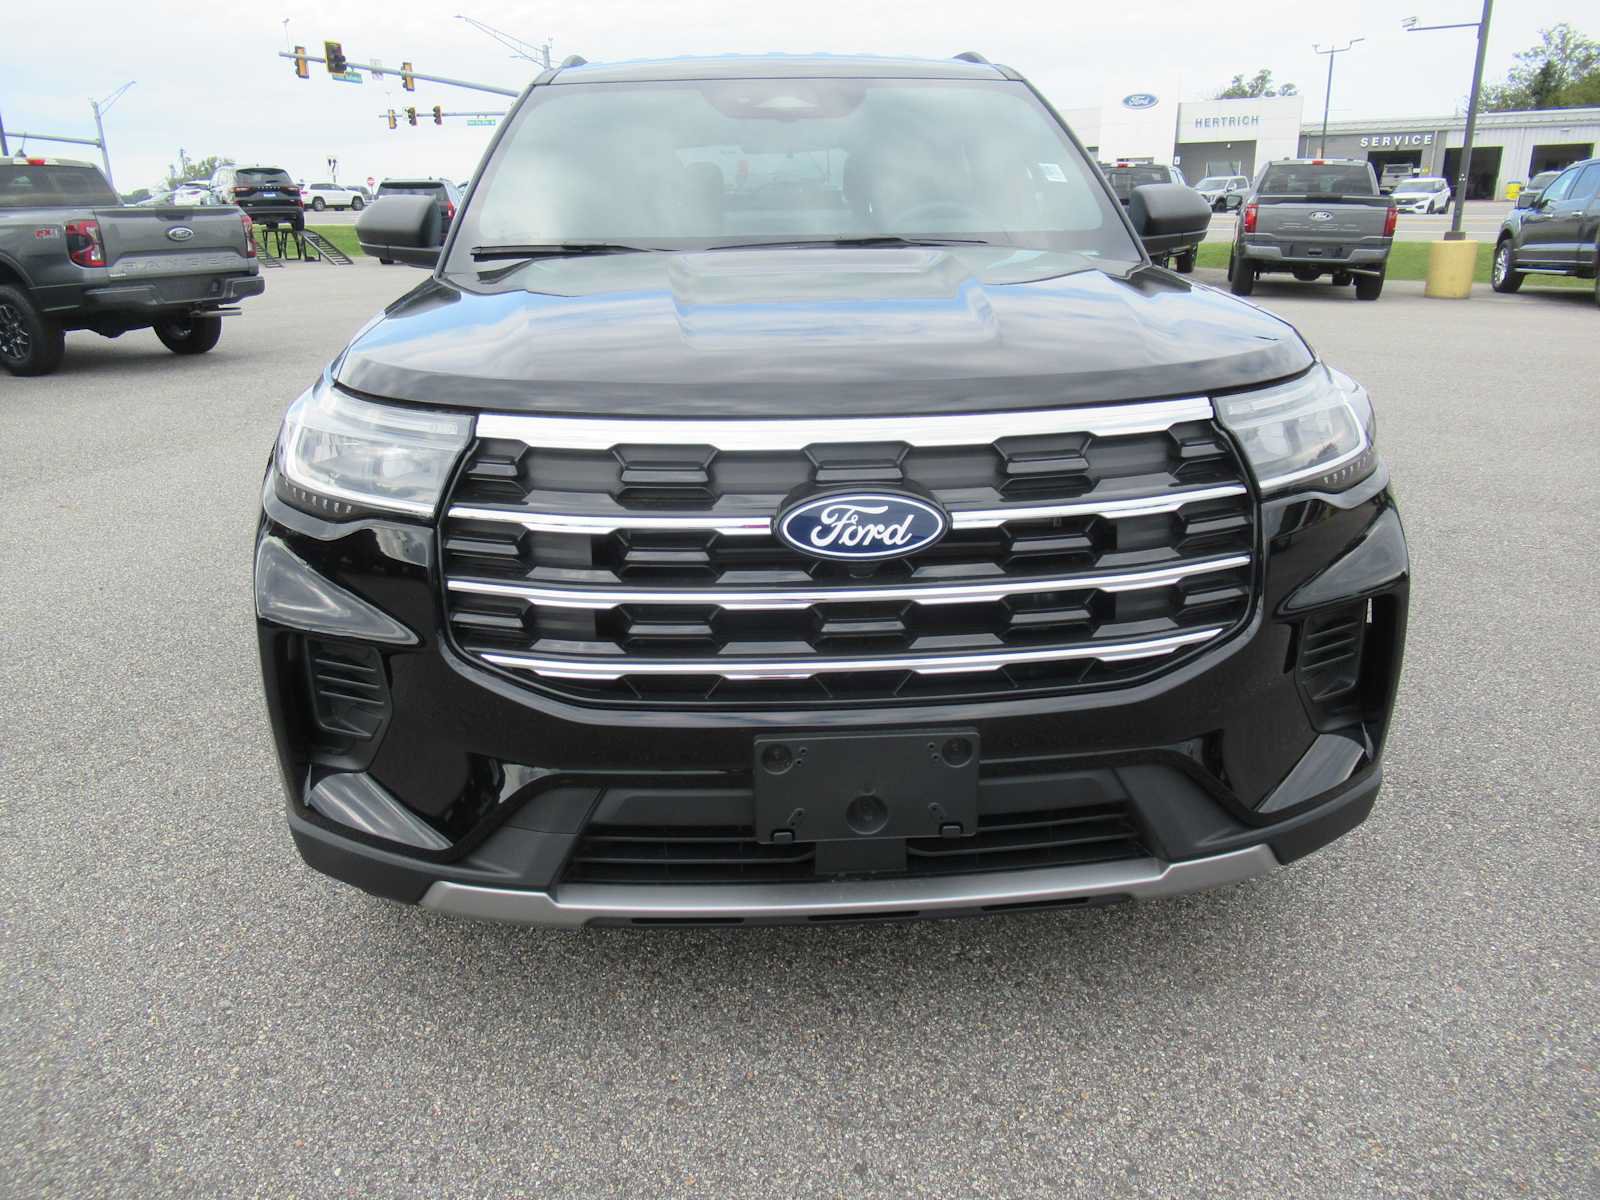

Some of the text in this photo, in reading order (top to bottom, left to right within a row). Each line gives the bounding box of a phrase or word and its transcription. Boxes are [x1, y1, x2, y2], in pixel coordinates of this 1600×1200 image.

[1195, 115, 1259, 129] HERTRICH
[1360, 134, 1433, 148] SERVICE
[810, 504, 915, 547] Ford
